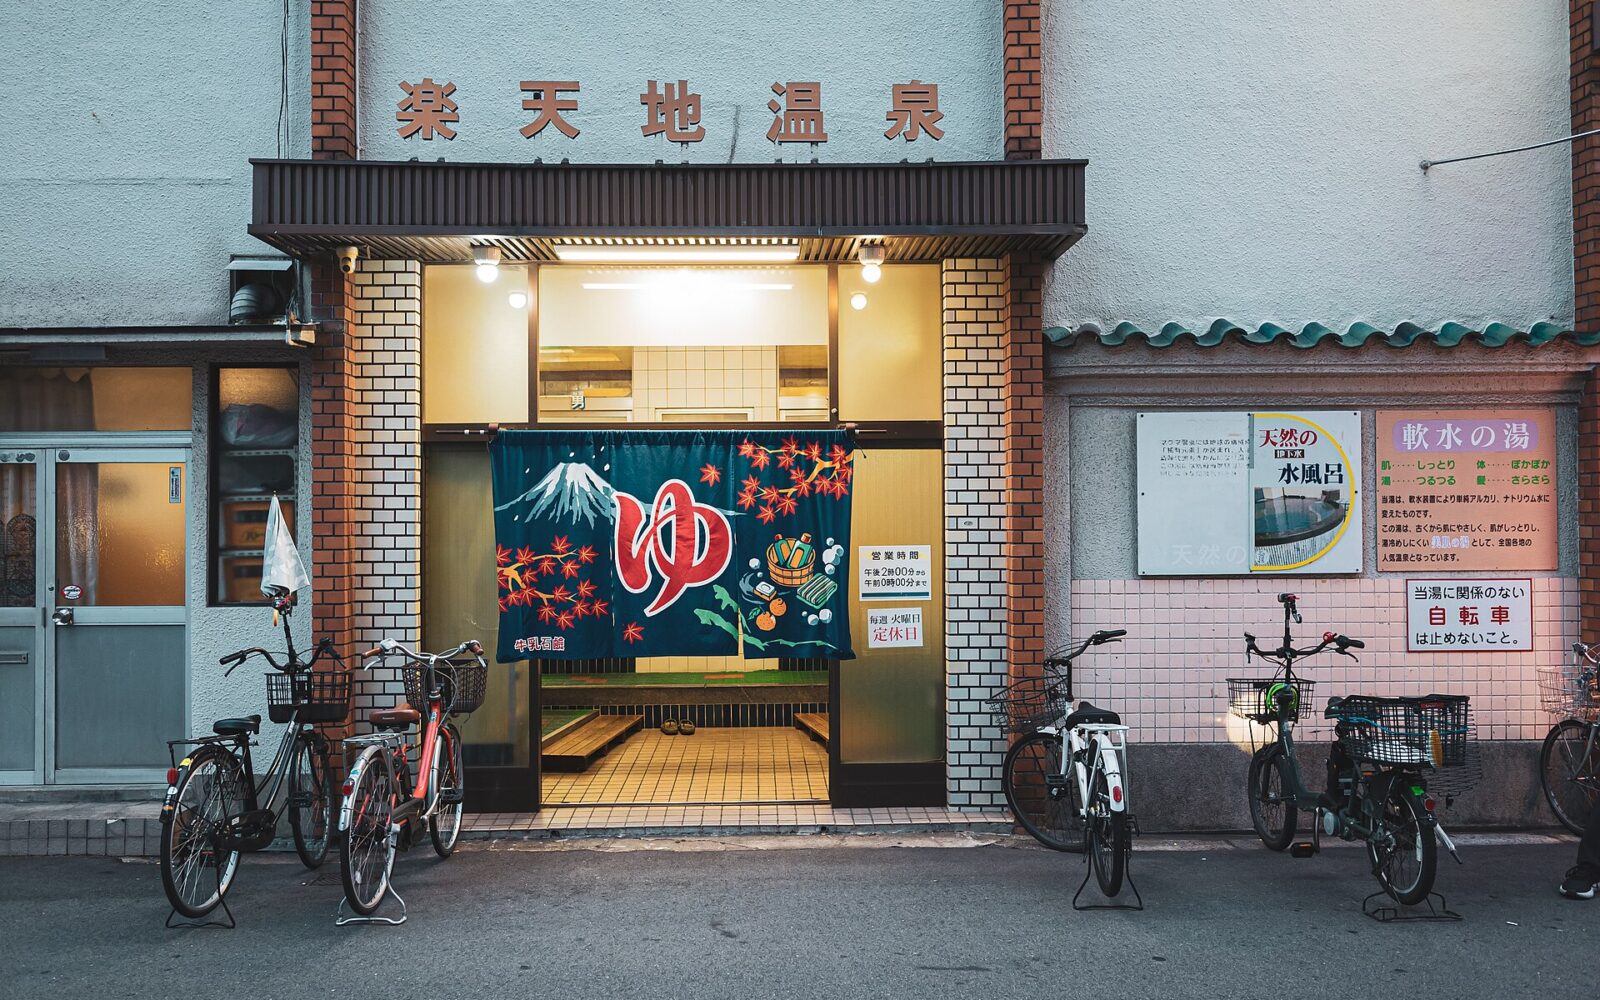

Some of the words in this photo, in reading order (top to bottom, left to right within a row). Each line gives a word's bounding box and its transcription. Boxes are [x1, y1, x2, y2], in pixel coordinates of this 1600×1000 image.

[396, 78, 945, 142] 楽天地温泉
[572, 391, 585, 410] 男
[1258, 428, 1318, 447] 天然の
[1402, 422, 1530, 450] 軟水の湯
[1278, 463, 1343, 484] 水風呂
[614, 478, 733, 618] ゆ
[871, 551, 919, 560] 営業時間
[1415, 586, 1525, 600] 当湯に関係のない
[891, 613, 920, 624] 火曜日
[1429, 605, 1510, 625] 自転車
[873, 627, 917, 642] 定休日
[1416, 631, 1518, 645] は止めないこと。
